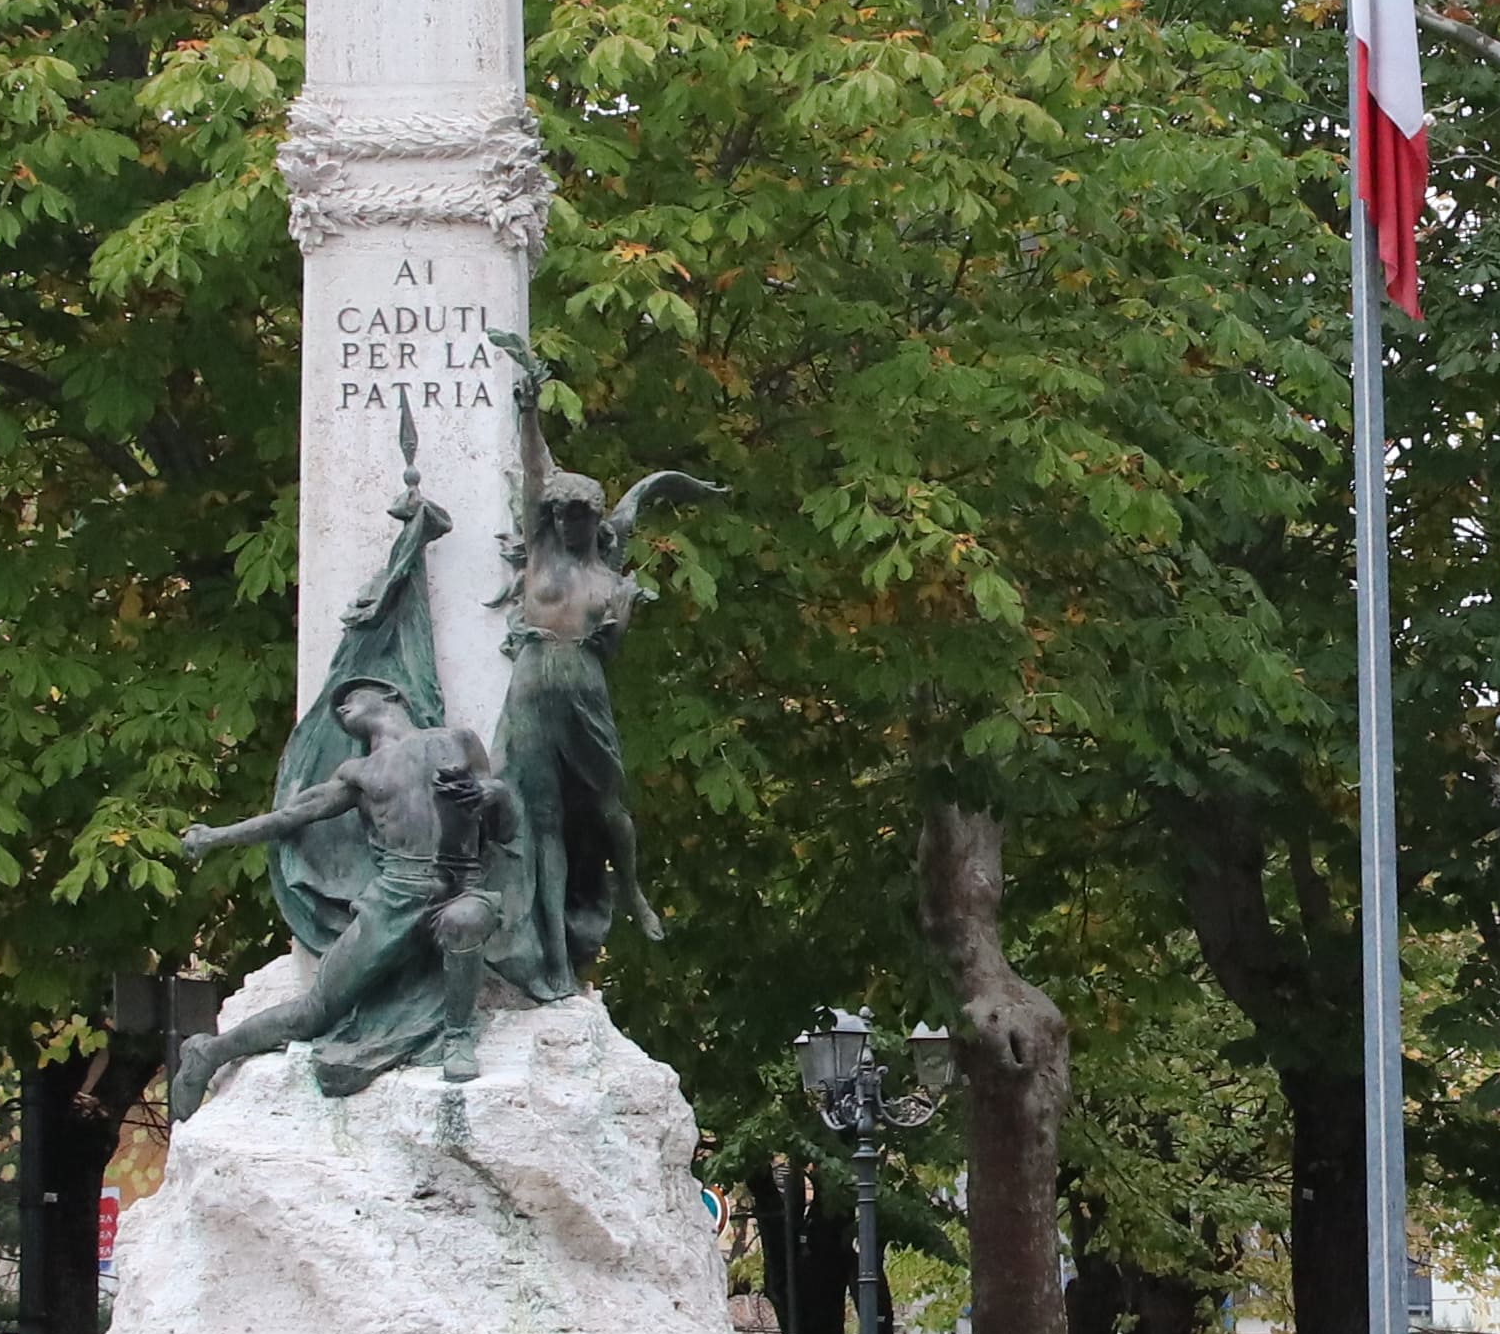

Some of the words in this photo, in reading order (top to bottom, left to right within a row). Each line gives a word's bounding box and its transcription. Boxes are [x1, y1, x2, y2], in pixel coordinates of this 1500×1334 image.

[393, 258, 433, 286] AI
[337, 306, 487, 335] CADUTI
[341, 342, 418, 369] PER
[445, 342, 492, 369] LA
[340, 381, 494, 409] PATRIA
